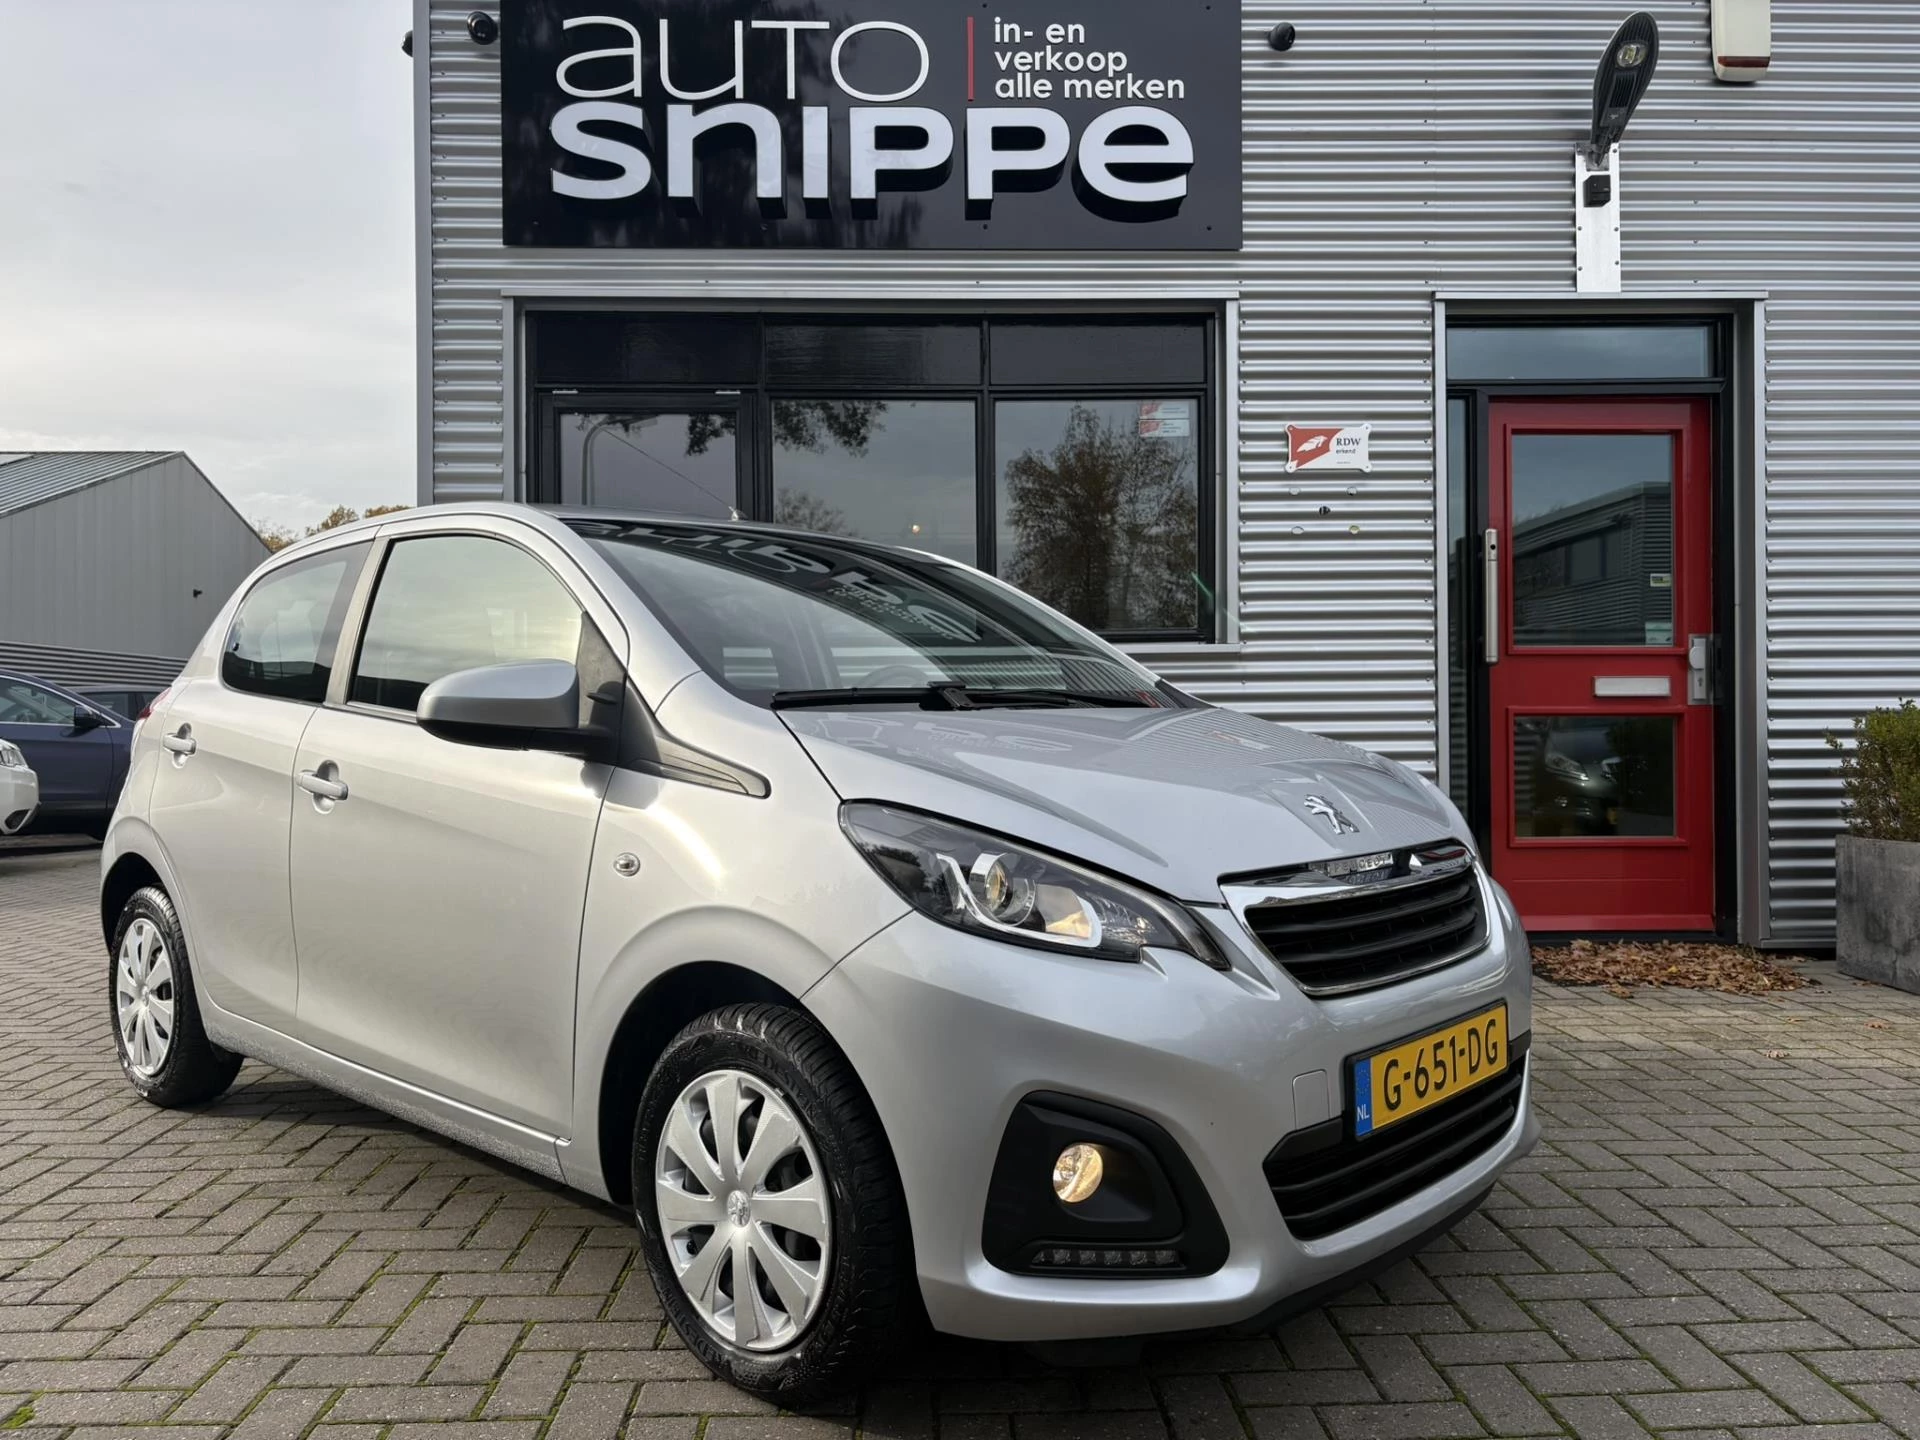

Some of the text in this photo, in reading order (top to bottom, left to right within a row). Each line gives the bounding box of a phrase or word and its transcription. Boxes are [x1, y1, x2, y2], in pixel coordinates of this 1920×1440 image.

[994, 16, 1085, 44] in- en
[994, 45, 1128, 77] verkoop
[994, 72, 1185, 99] alle merken
[1336, 437, 1361, 446] RDW
[1383, 1018, 1498, 1111] G-651-DG
[1356, 1103, 1370, 1122] NL
